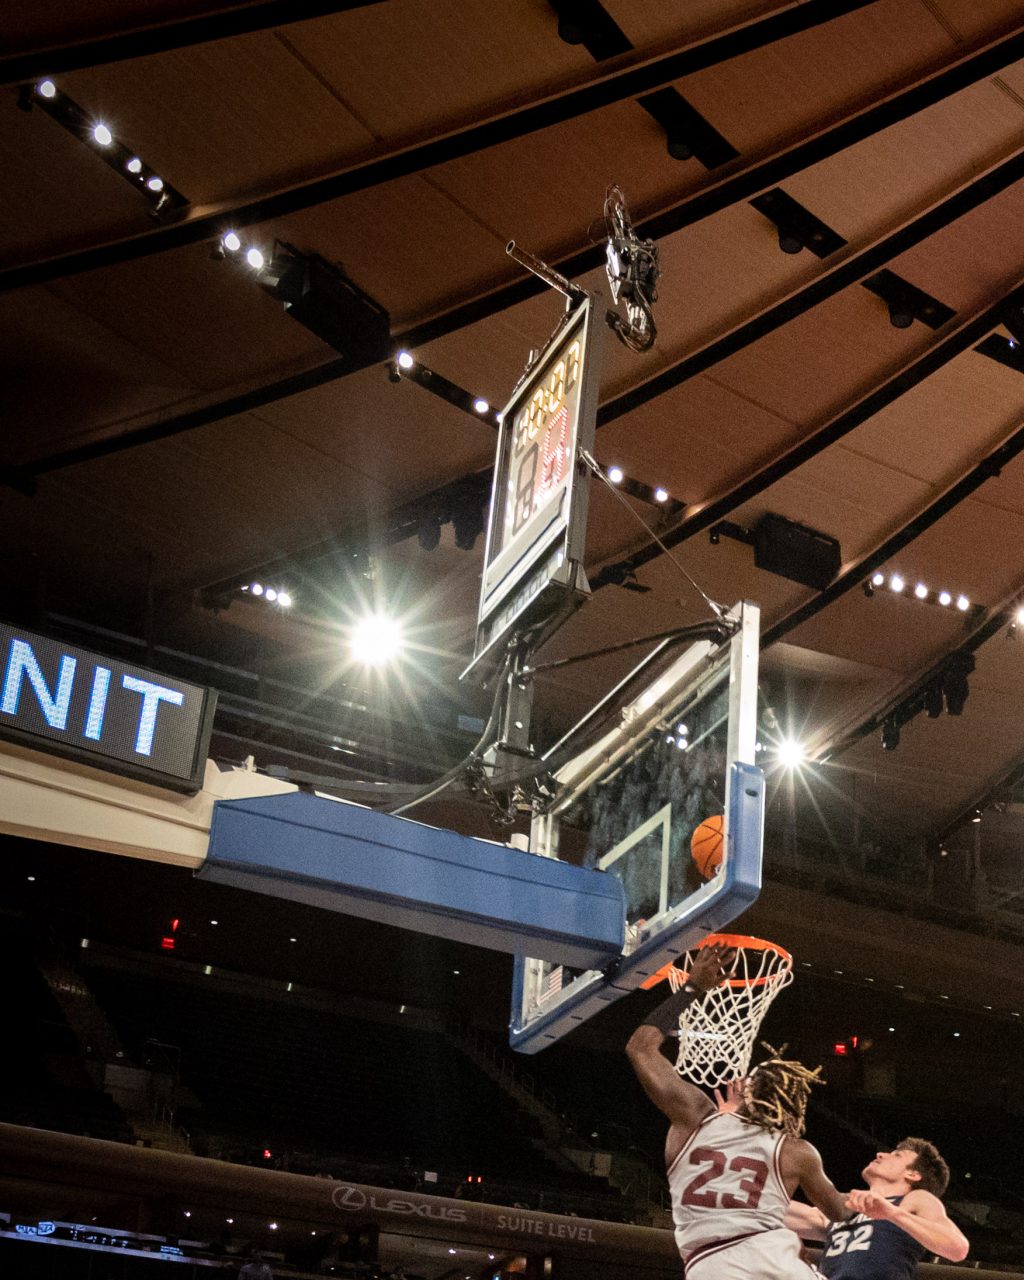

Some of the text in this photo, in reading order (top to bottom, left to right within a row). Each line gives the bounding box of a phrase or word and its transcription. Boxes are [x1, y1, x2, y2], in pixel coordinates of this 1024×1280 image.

[1, 637, 185, 757] NIT
[681, 1146, 769, 1209] 23
[370, 1196, 596, 1242] LEXUS SUITE LEVEL
[825, 1224, 874, 1257] 32
